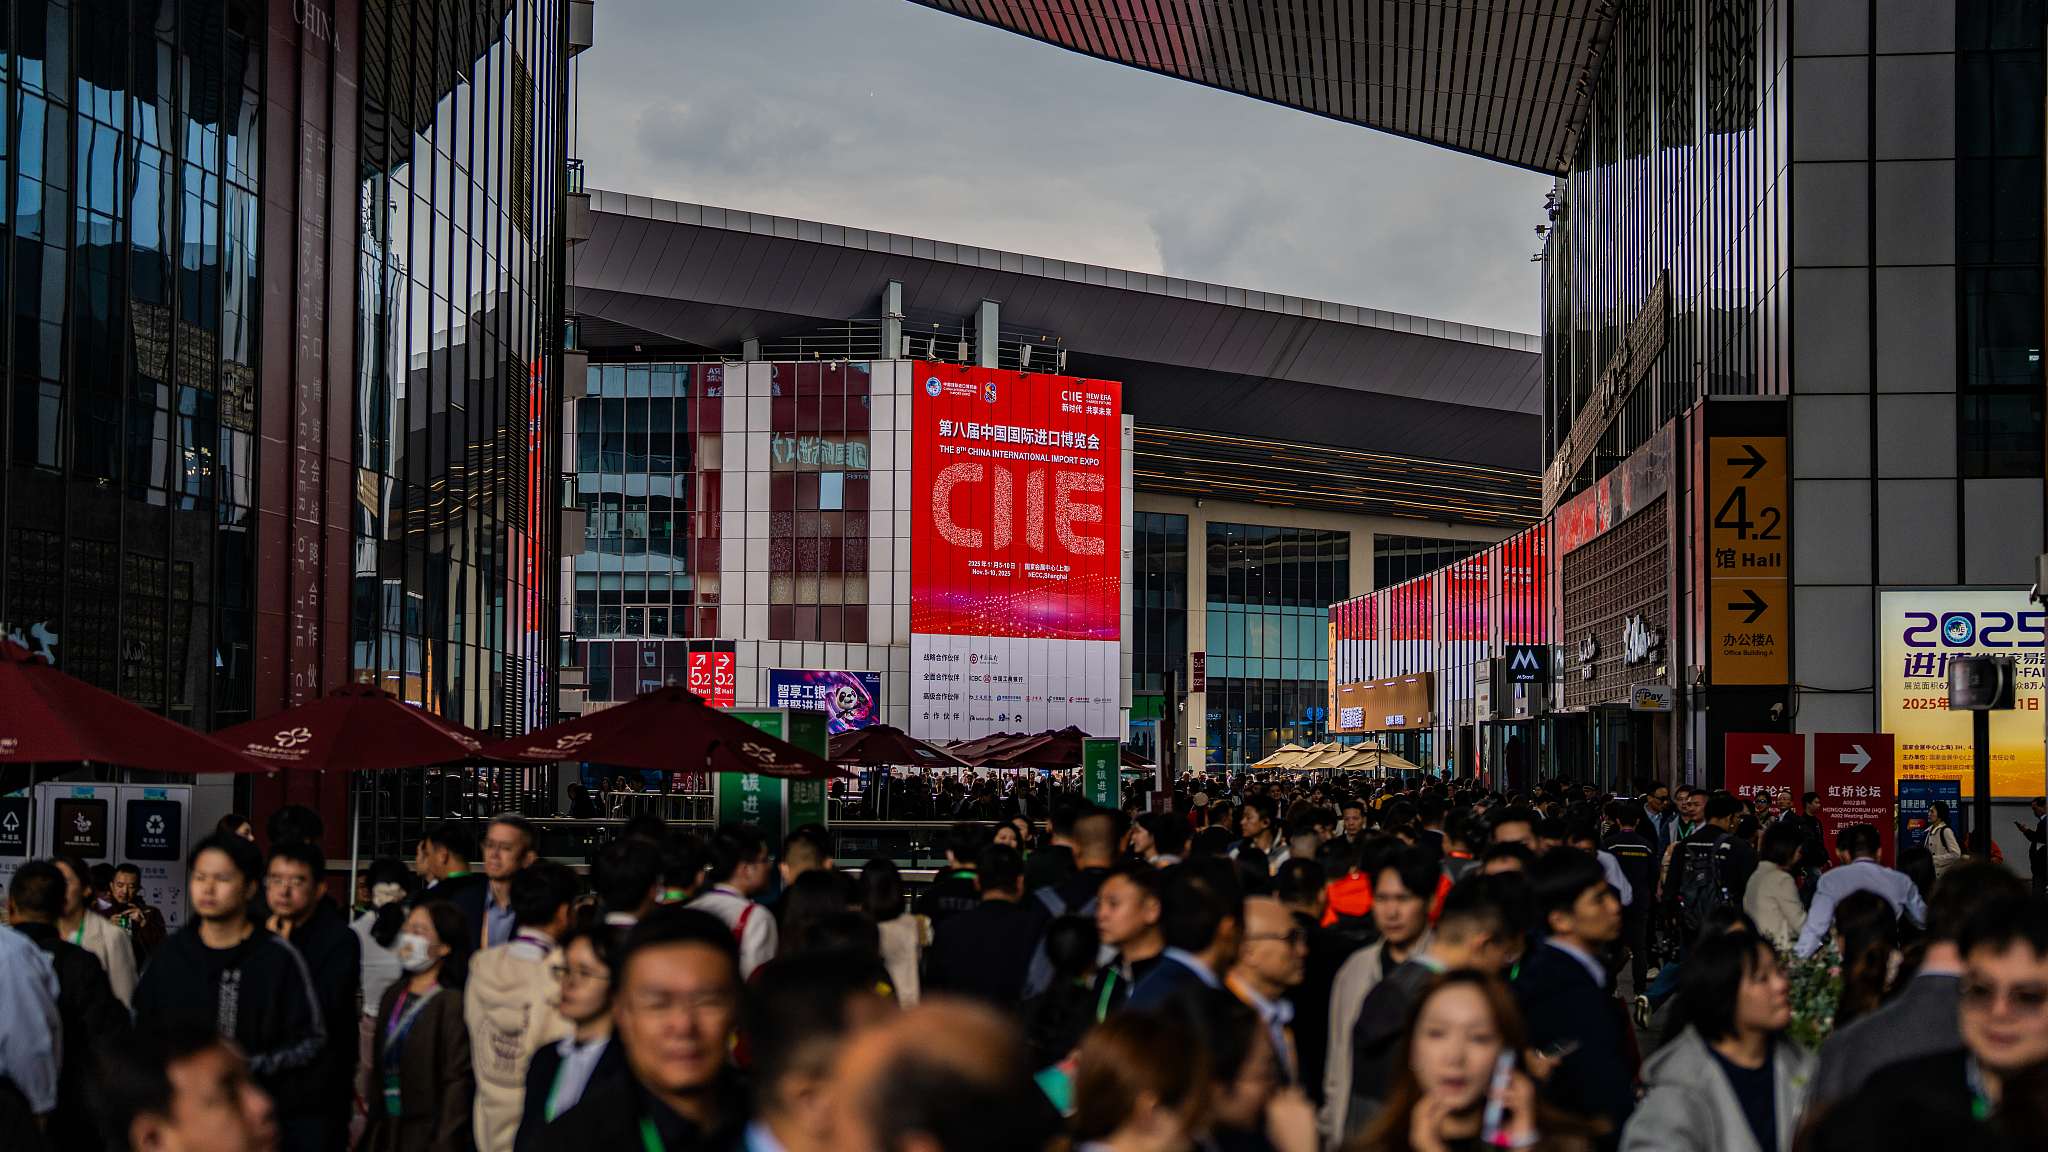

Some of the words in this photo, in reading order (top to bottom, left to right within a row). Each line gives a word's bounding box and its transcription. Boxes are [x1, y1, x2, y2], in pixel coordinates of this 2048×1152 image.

[1062, 390, 1082, 402] CIIE
[1062, 403, 1082, 414] 新时代
[1086, 405, 1112, 416] 共享未来
[939, 419, 1100, 450] 第八届中国国际进口博览会
[298, 384, 308, 511] PARTNER
[940, 445, 954, 454] THE
[968, 448, 991, 457] CHINA
[992, 450, 1050, 462] INTERNATIONAL
[1052, 454, 1078, 465] IMPORT
[1080, 457, 1100, 466] EXPO
[932, 462, 1105, 555] CIIE
[1714, 486, 1781, 540] 4.2
[297, 537, 306, 571] OF
[1716, 548, 1736, 568] 馆
[1742, 553, 1781, 567] Hall
[296, 596, 305, 648] THE
[1903, 612, 2045, 647] 2025
[1722, 634, 1774, 646] 办公楼A
[923, 654, 960, 662] 战略合作伙伴
[690, 667, 711, 686] 5.2
[715, 666, 734, 686] 5.2
[923, 673, 960, 681] 全面合作伙伴
[778, 684, 826, 699] 智享工银
[923, 692, 960, 701] 高级合作伙伴
[1828, 786, 1881, 798] 虹桥论坛
